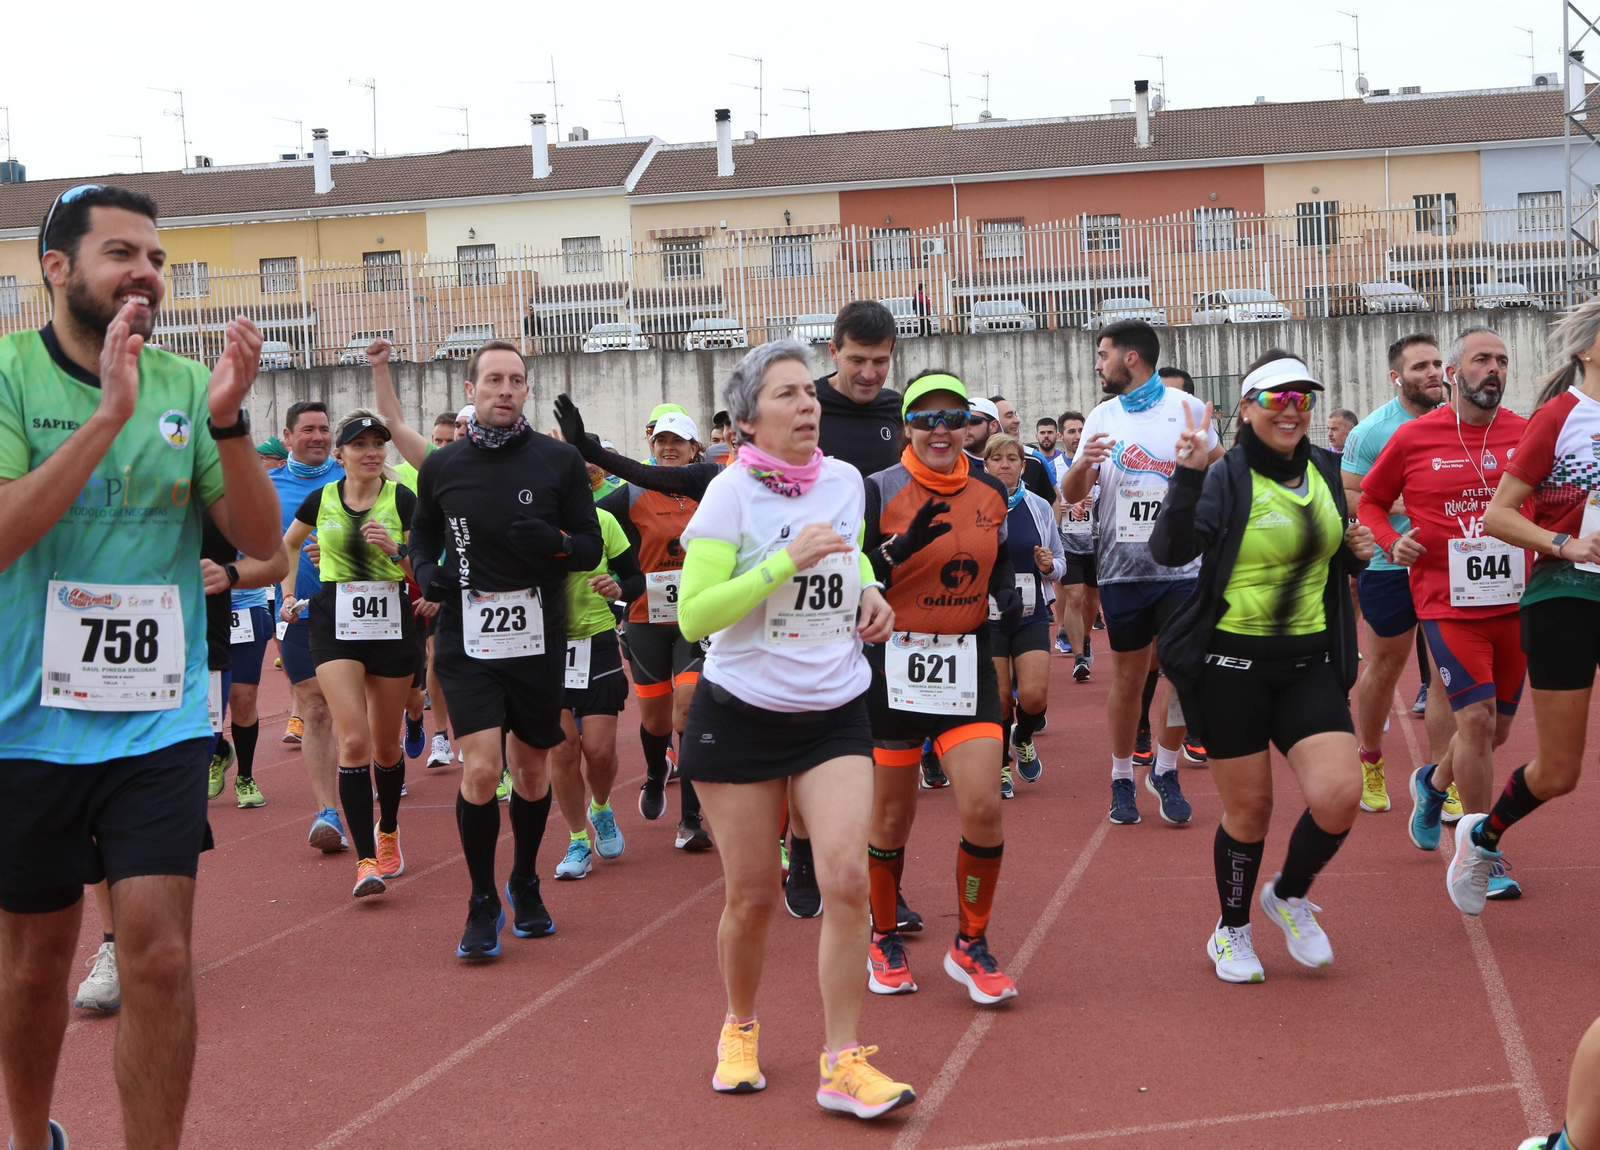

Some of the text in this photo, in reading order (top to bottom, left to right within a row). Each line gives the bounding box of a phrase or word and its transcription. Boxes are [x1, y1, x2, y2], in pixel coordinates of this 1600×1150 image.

[33, 417, 79, 430] SAPIE
[1462, 487, 1498, 498] ATLETIS
[1129, 501, 1162, 522] 472
[459, 517, 471, 547] Team
[1466, 554, 1511, 581] 644
[793, 573, 843, 611] 738
[352, 596, 388, 619] 941
[480, 605, 527, 633] 223
[80, 618, 159, 664] 758
[908, 652, 957, 684] 621
